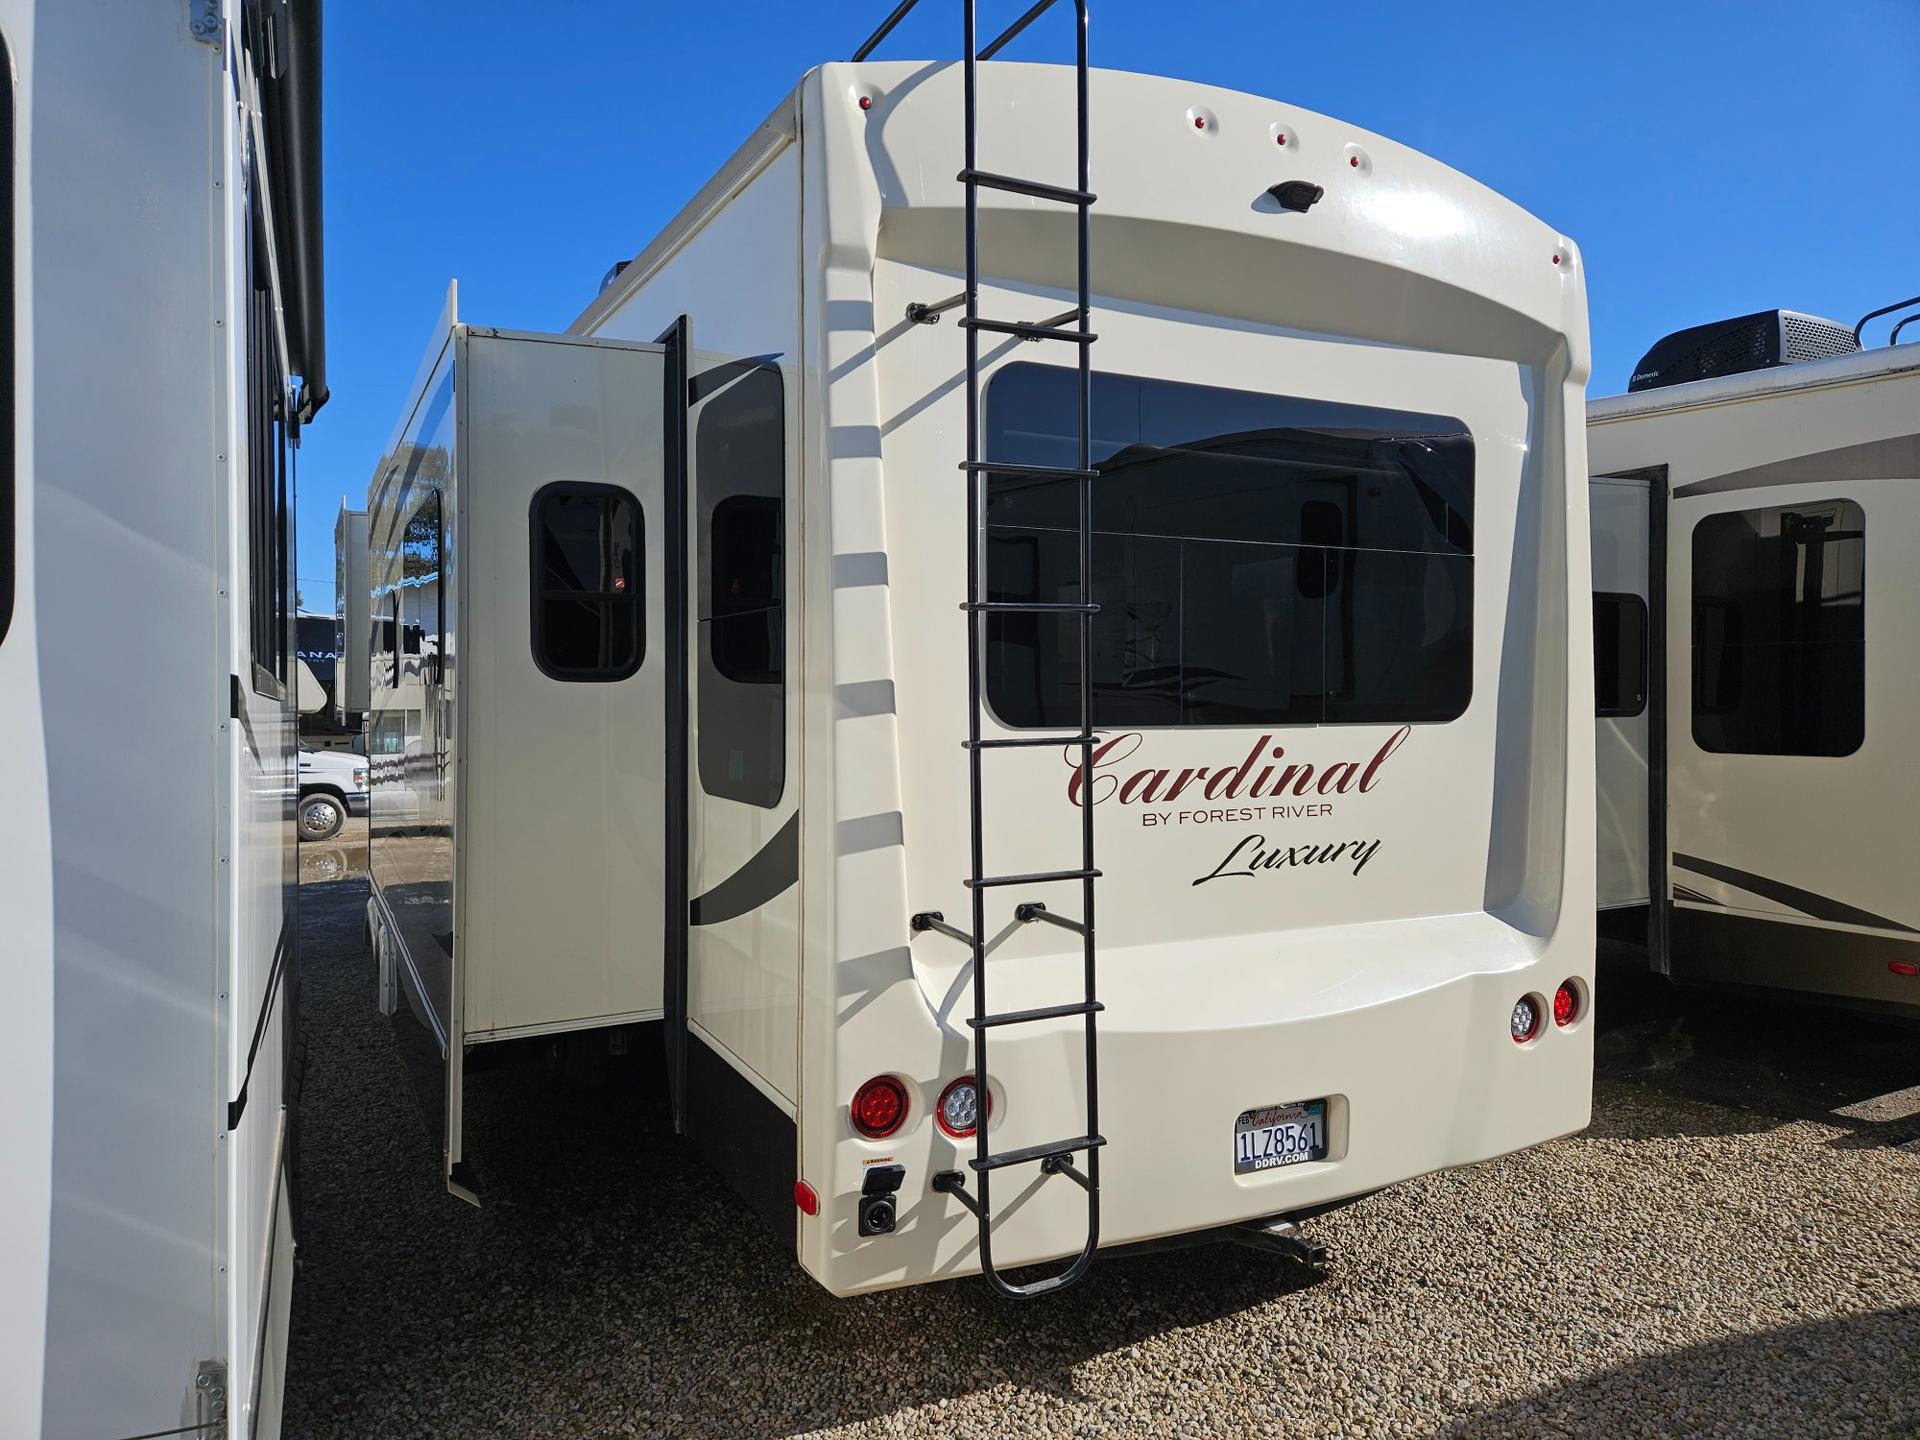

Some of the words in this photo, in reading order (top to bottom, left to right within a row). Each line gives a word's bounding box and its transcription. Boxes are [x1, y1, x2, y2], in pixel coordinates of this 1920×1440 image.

[1064, 725, 1412, 807] Cardinal
[1142, 812, 1171, 827] BY
[1179, 807, 1267, 825] FOREST
[1272, 803, 1334, 819] RIVER
[1192, 834, 1383, 887] Luxury
[1251, 1110, 1308, 1126] California
[1240, 1122, 1320, 1162] 1LZ8561
[1255, 1152, 1309, 1169] DDRV.COM
